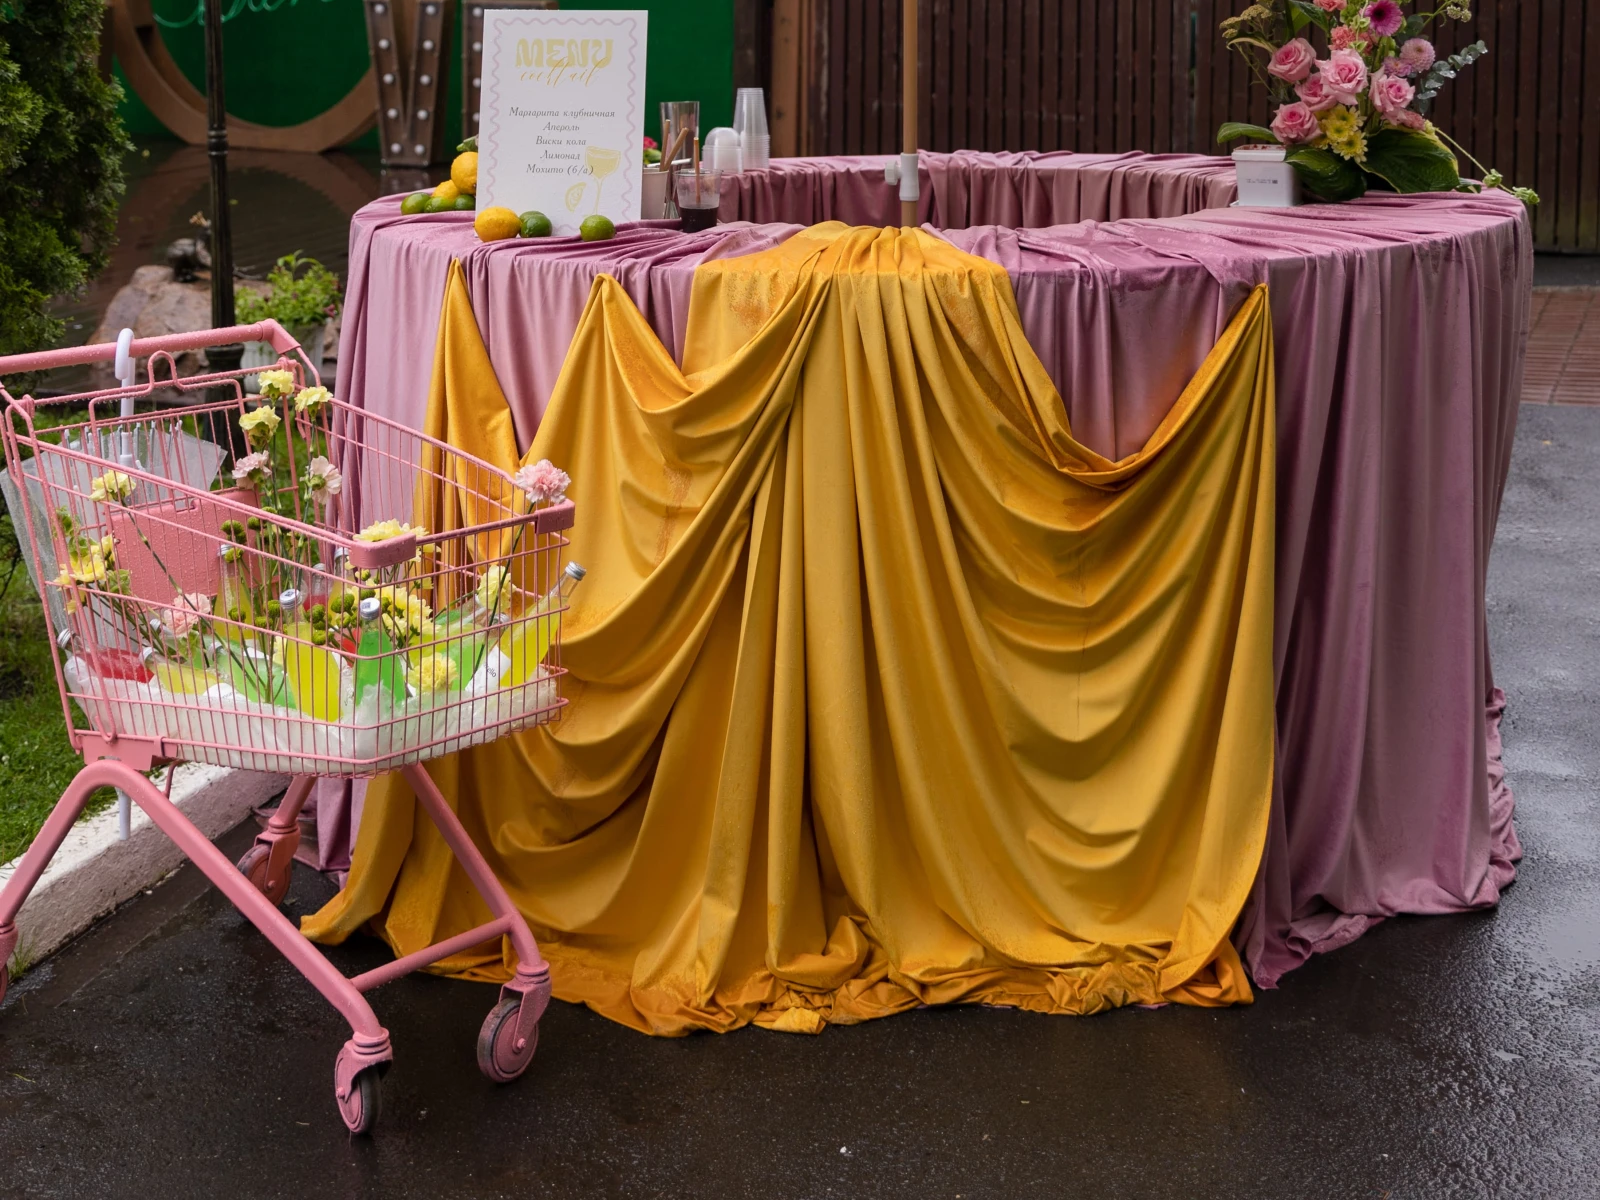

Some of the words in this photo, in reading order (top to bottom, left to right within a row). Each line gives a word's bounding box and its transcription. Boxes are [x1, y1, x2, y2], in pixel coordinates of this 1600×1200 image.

[515, 38, 614, 69] MENU
[509, 106, 559, 118] Маргарита
[562, 108, 615, 118] клубничная
[542, 121, 580, 132] Апероль
[535, 135, 562, 146] Виски
[540, 150, 580, 161] Лимонад
[526, 164, 564, 174] Мохито
